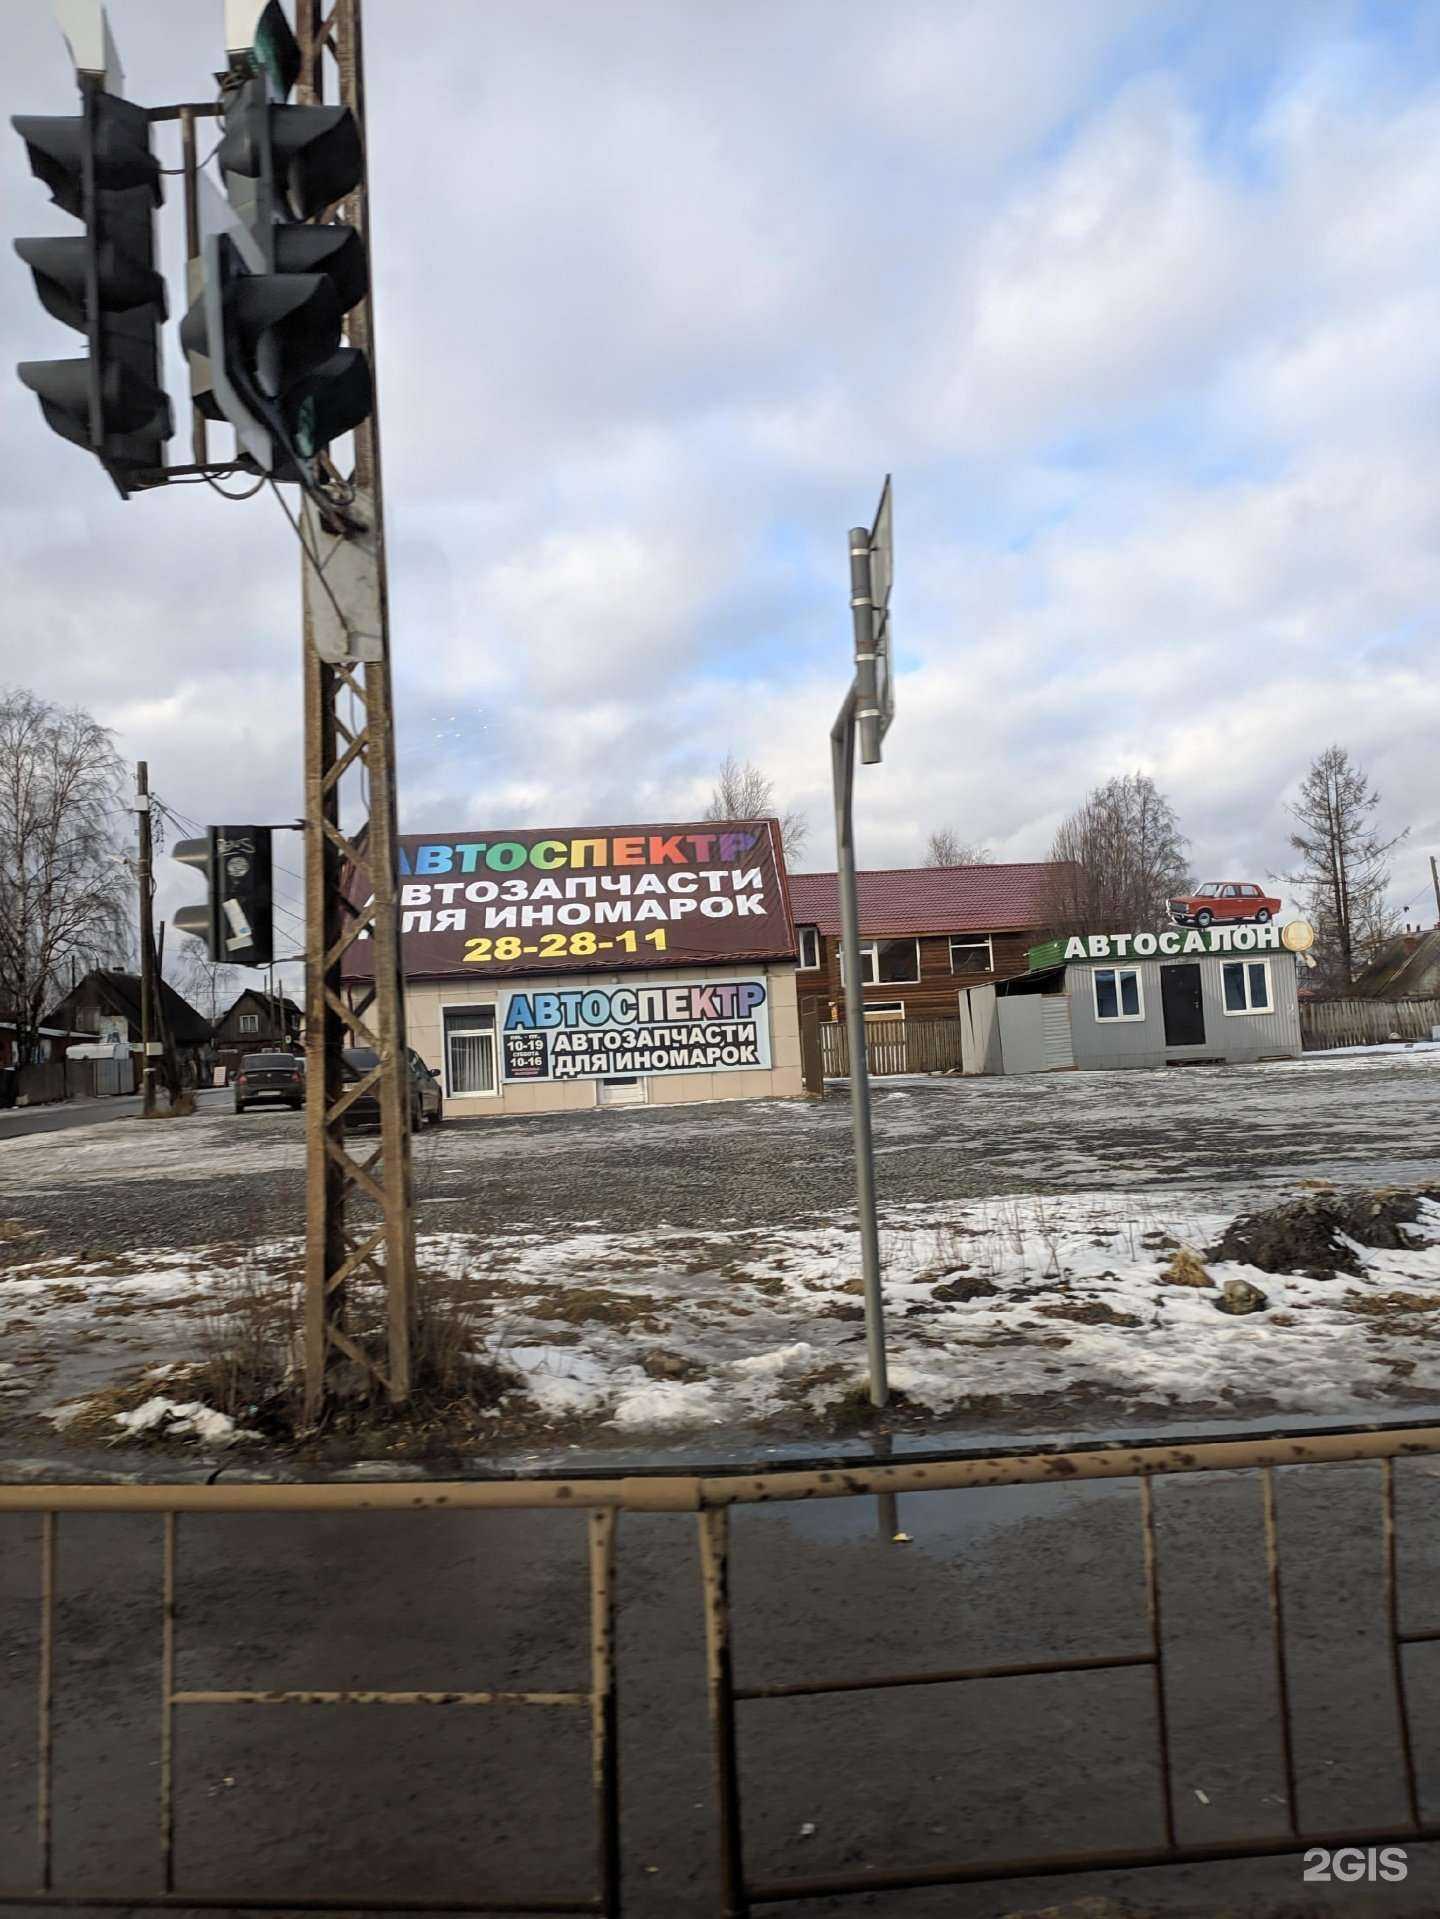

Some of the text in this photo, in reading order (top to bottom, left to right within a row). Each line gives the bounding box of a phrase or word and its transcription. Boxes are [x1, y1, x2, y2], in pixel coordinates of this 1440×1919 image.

[364, 867, 763, 908] ВТОЗАПЧАСТИ
[358, 893, 768, 939] ЛЯ ИНОМАРОК
[463, 929, 668, 961] 28-28-11
[1064, 925, 1281, 959] АВТОСАЛОН
[504, 982, 766, 1030] АВТОСПЕКТР
[507, 1040, 544, 1051] 10-19
[554, 1024, 755, 1052] АВТОЗАПЧАСТИ
[510, 1057, 542, 1067] 10-16
[554, 1045, 757, 1077] ДЛЯ ИНОМАРОК
